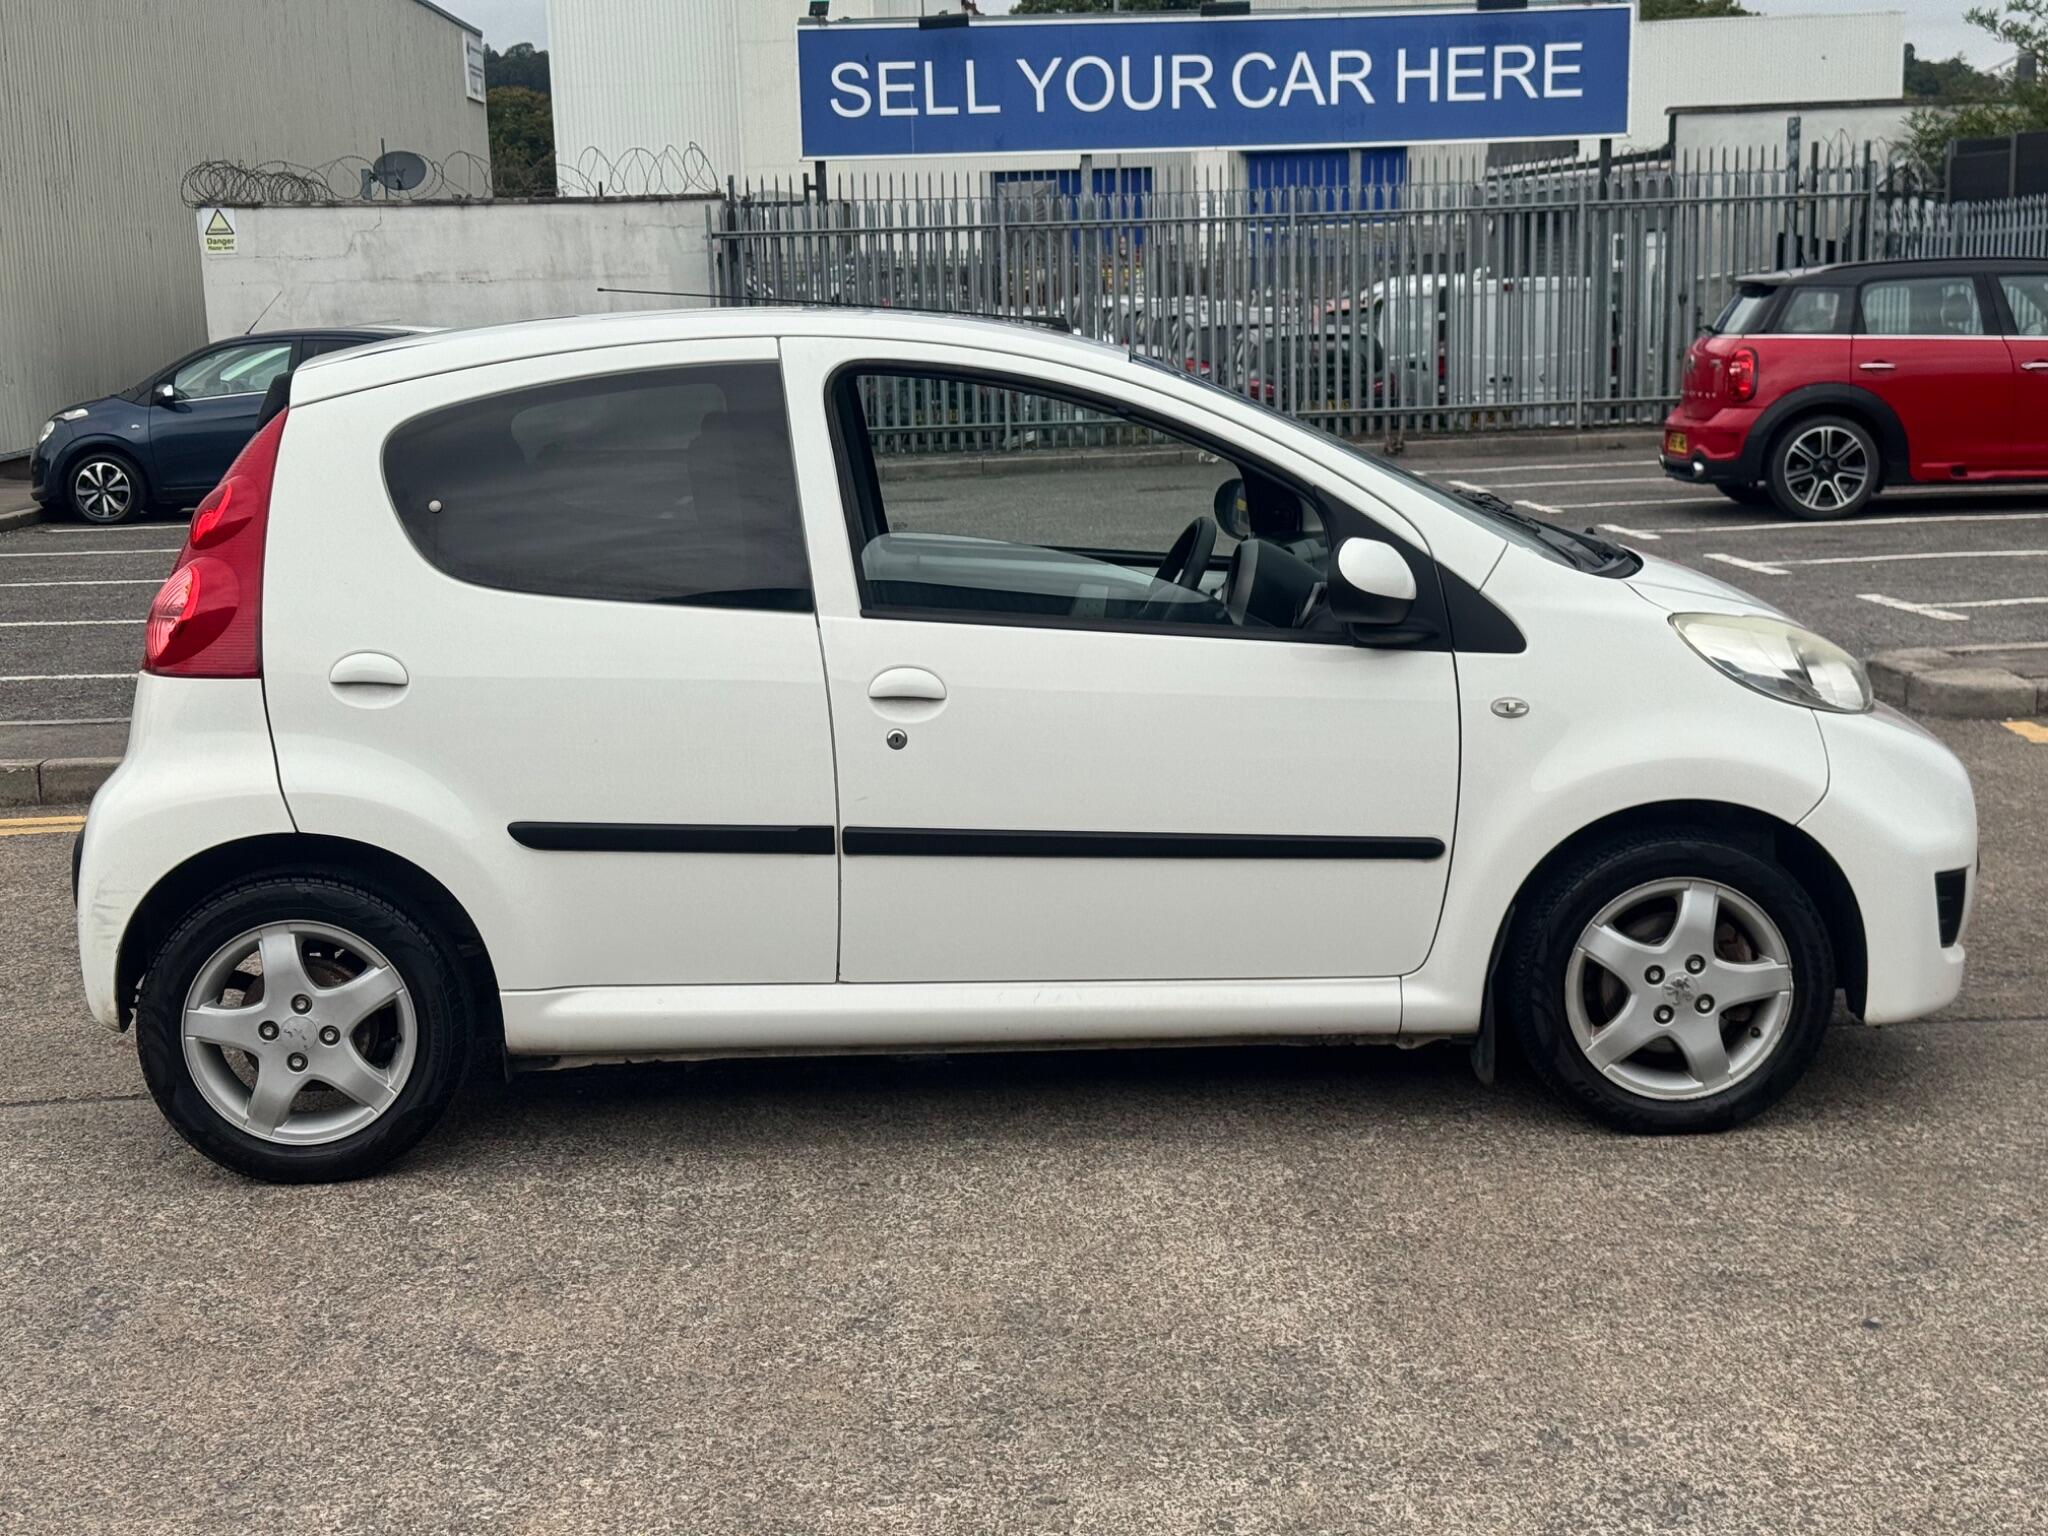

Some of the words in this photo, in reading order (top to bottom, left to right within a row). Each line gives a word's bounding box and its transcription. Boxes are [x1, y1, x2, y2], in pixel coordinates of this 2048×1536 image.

[830, 60, 1001, 118] SELL
[1016, 54, 1217, 113] YOUR
[1231, 49, 1375, 109] CAR
[1397, 42, 1583, 104] HERE
[206, 237, 235, 246] Danger
